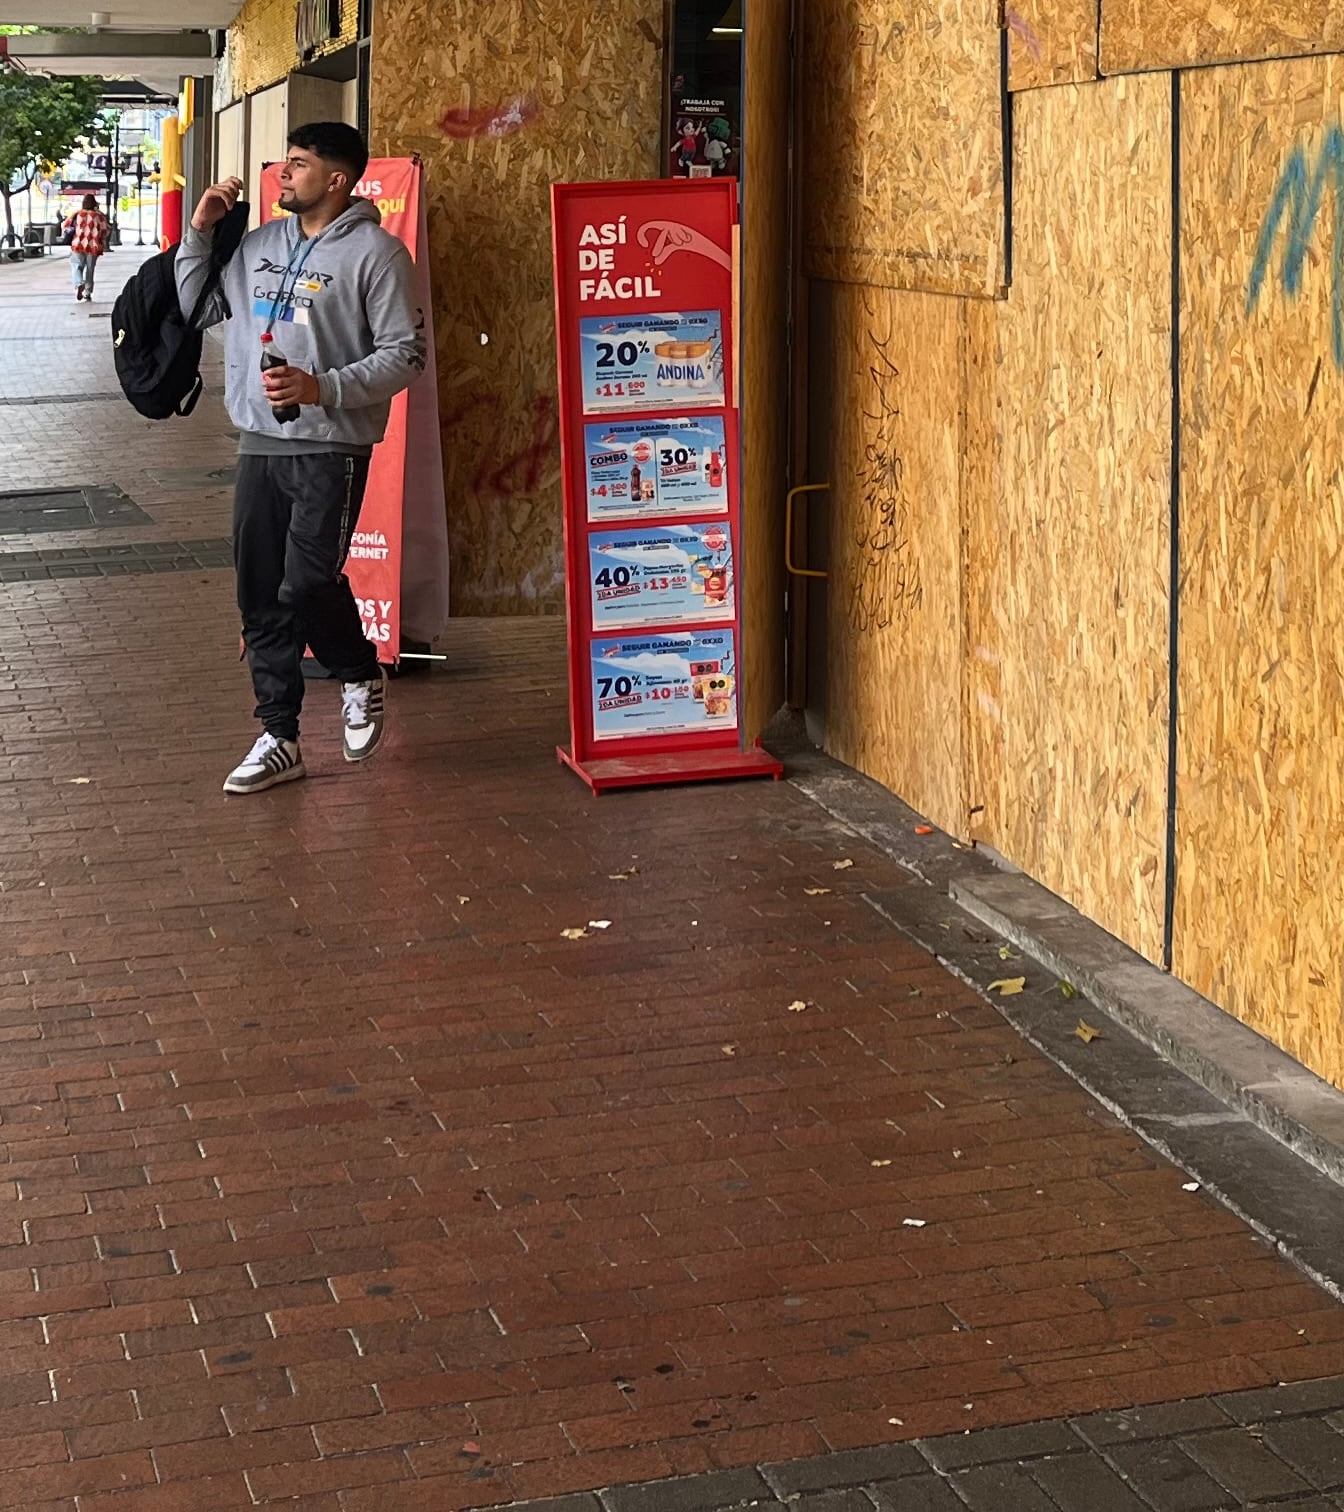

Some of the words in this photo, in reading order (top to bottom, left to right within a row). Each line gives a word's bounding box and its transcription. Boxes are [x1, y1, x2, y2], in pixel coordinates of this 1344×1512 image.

[377, 193, 406, 217] QUÍ
[578, 215, 627, 246] ASÍ
[578, 248, 615, 271] DE
[579, 271, 661, 301] FÁCIL
[596, 340, 650, 368] 20%
[657, 363, 705, 380] ANDINA
[590, 452, 628, 466] COMBO
[660, 447, 697, 466] 30%
[351, 529, 387, 546] FONÍA
[595, 565, 640, 587] 40%
[378, 600, 393, 619] Y
[597, 674, 642, 698] 70%
